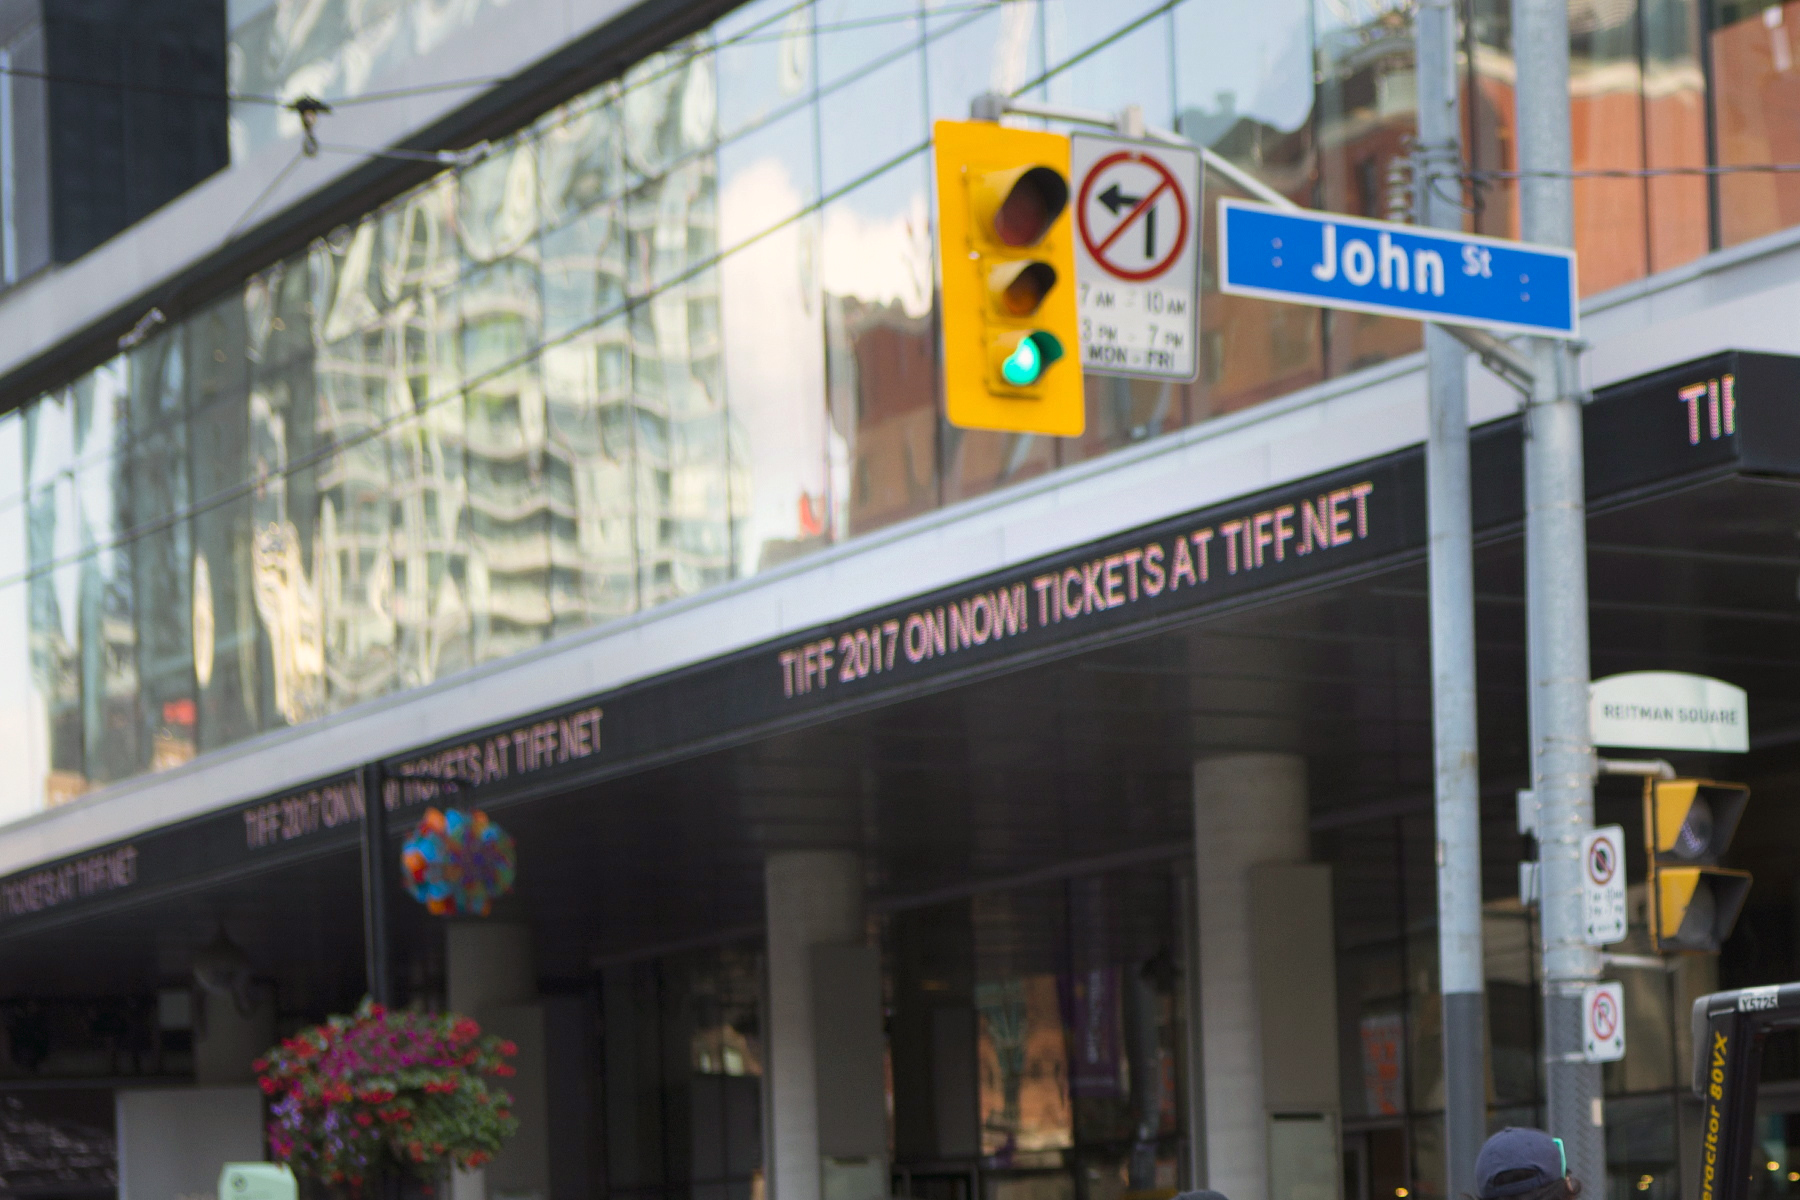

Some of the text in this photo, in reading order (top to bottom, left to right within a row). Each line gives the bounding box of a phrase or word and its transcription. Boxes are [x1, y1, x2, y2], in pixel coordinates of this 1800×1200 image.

[1312, 223, 1492, 297] John St
[1146, 290, 1164, 314] 10
[1087, 344, 1175, 368] MON FRI
[778, 480, 1374, 698] TIFF 2017 ON NOW! TICKETS AT TIFF.NET
[1604, 704, 1738, 725] REITMAN SQUARE
[1709, 1030, 1729, 1100] 80VX
